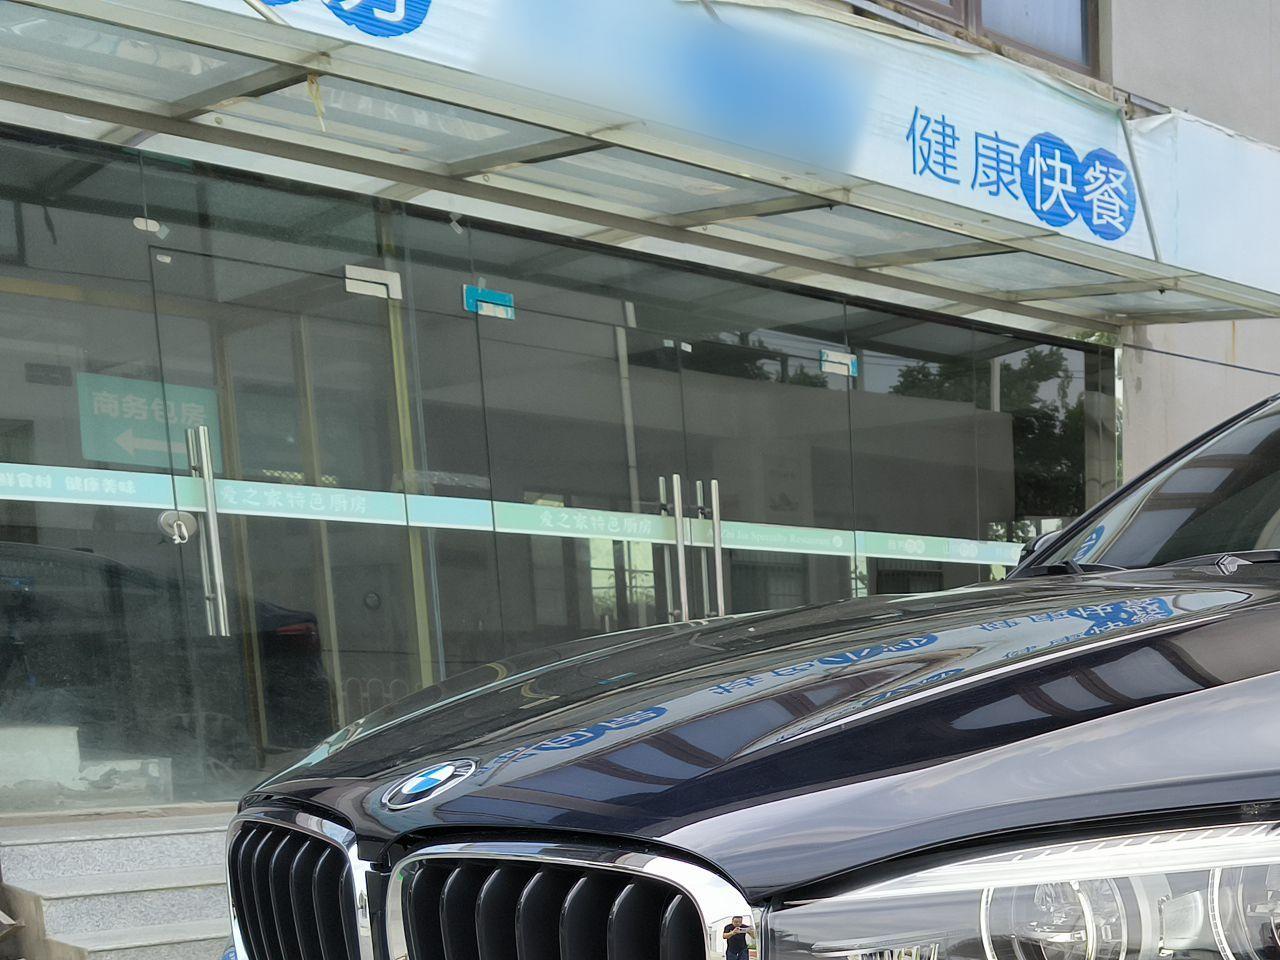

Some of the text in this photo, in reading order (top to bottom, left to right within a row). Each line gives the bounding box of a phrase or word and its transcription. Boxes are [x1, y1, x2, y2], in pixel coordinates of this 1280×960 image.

[906, 105, 1129, 233] 健康快餐
[92, 390, 206, 427] 商务包房
